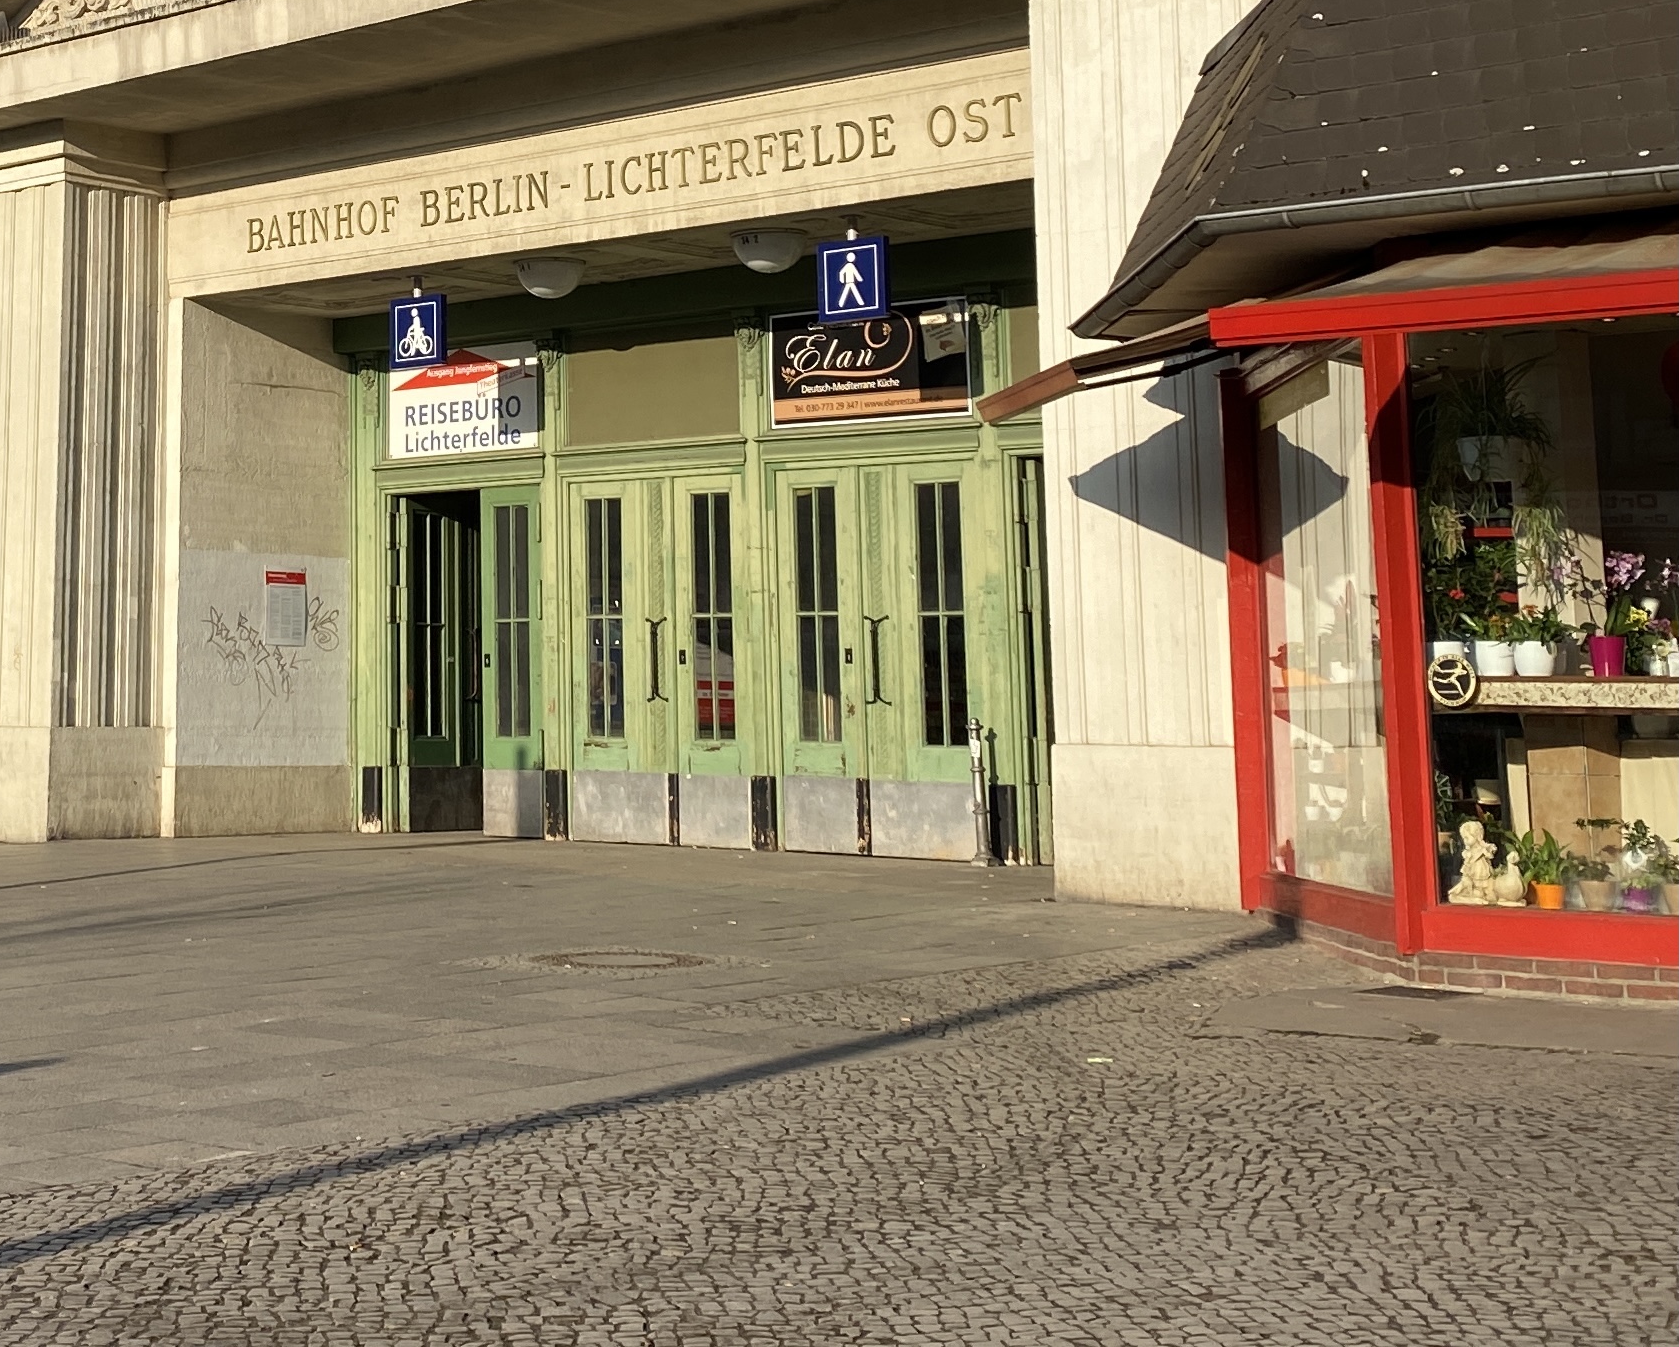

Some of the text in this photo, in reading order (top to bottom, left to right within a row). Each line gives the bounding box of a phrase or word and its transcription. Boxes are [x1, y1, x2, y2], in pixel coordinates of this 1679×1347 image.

[247, 195, 399, 253] BAHNHOF
[926, 92, 1022, 149] OST
[786, 334, 876, 373] Elan
[877, 377, 900, 388] Küche
[405, 393, 522, 428] REISEBÜRO
[405, 423, 522, 453] Lichterfelde
